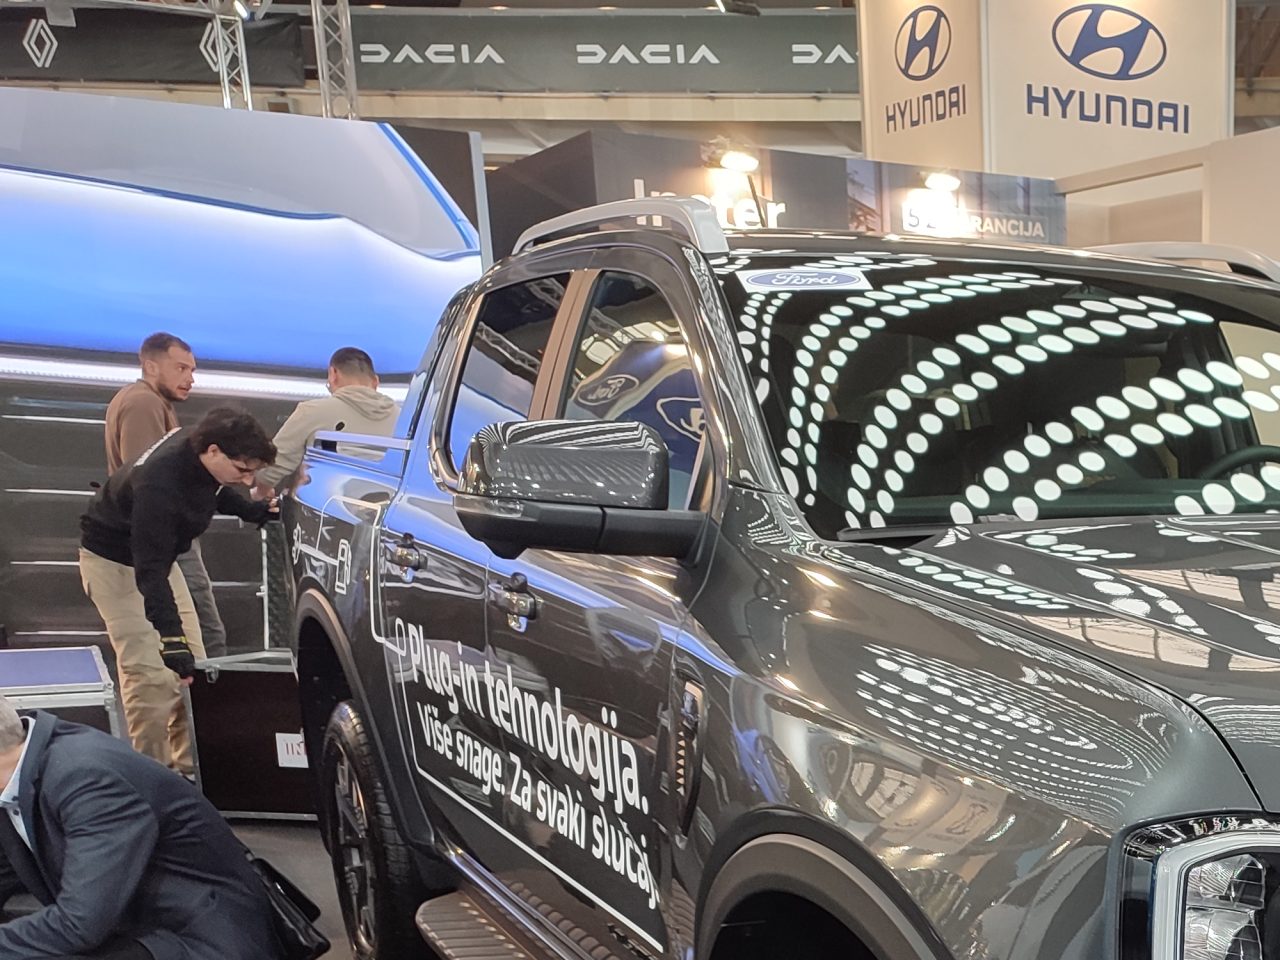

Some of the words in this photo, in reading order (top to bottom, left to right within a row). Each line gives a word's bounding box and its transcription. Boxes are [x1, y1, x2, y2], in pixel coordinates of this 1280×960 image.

[360, 43, 505, 64] DACIA
[577, 44, 720, 64] DACIA
[886, 84, 967, 134] HYUNDAI
[1026, 83, 1190, 134] HYUNDAI
[771, 272, 839, 285] Ford
[407, 622, 482, 716] Plug-in
[484, 660, 650, 815] tehnologija.
[417, 701, 453, 763] Više
[456, 730, 505, 797] snage.
[509, 751, 533, 815] Za
[536, 780, 586, 848] svaki
